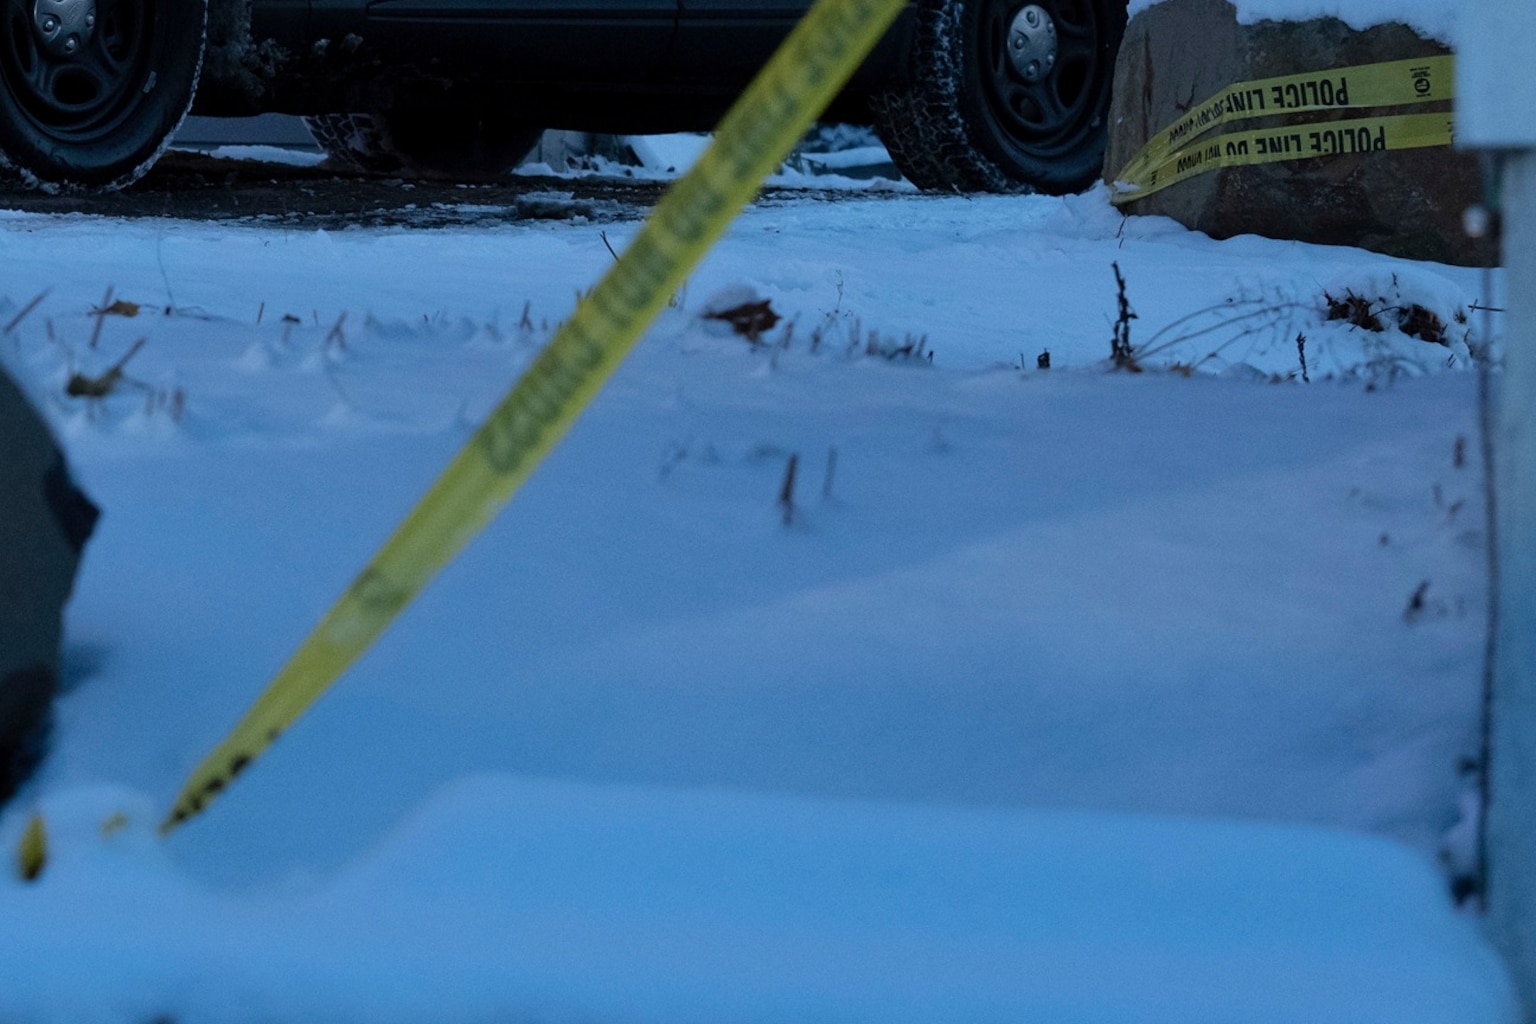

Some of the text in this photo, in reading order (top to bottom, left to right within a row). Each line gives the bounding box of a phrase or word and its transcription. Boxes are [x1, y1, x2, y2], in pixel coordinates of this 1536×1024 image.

[1272, 77, 1349, 109] POLICE
[1255, 134, 1302, 155] LINE
[1309, 126, 1386, 154] POLICE
